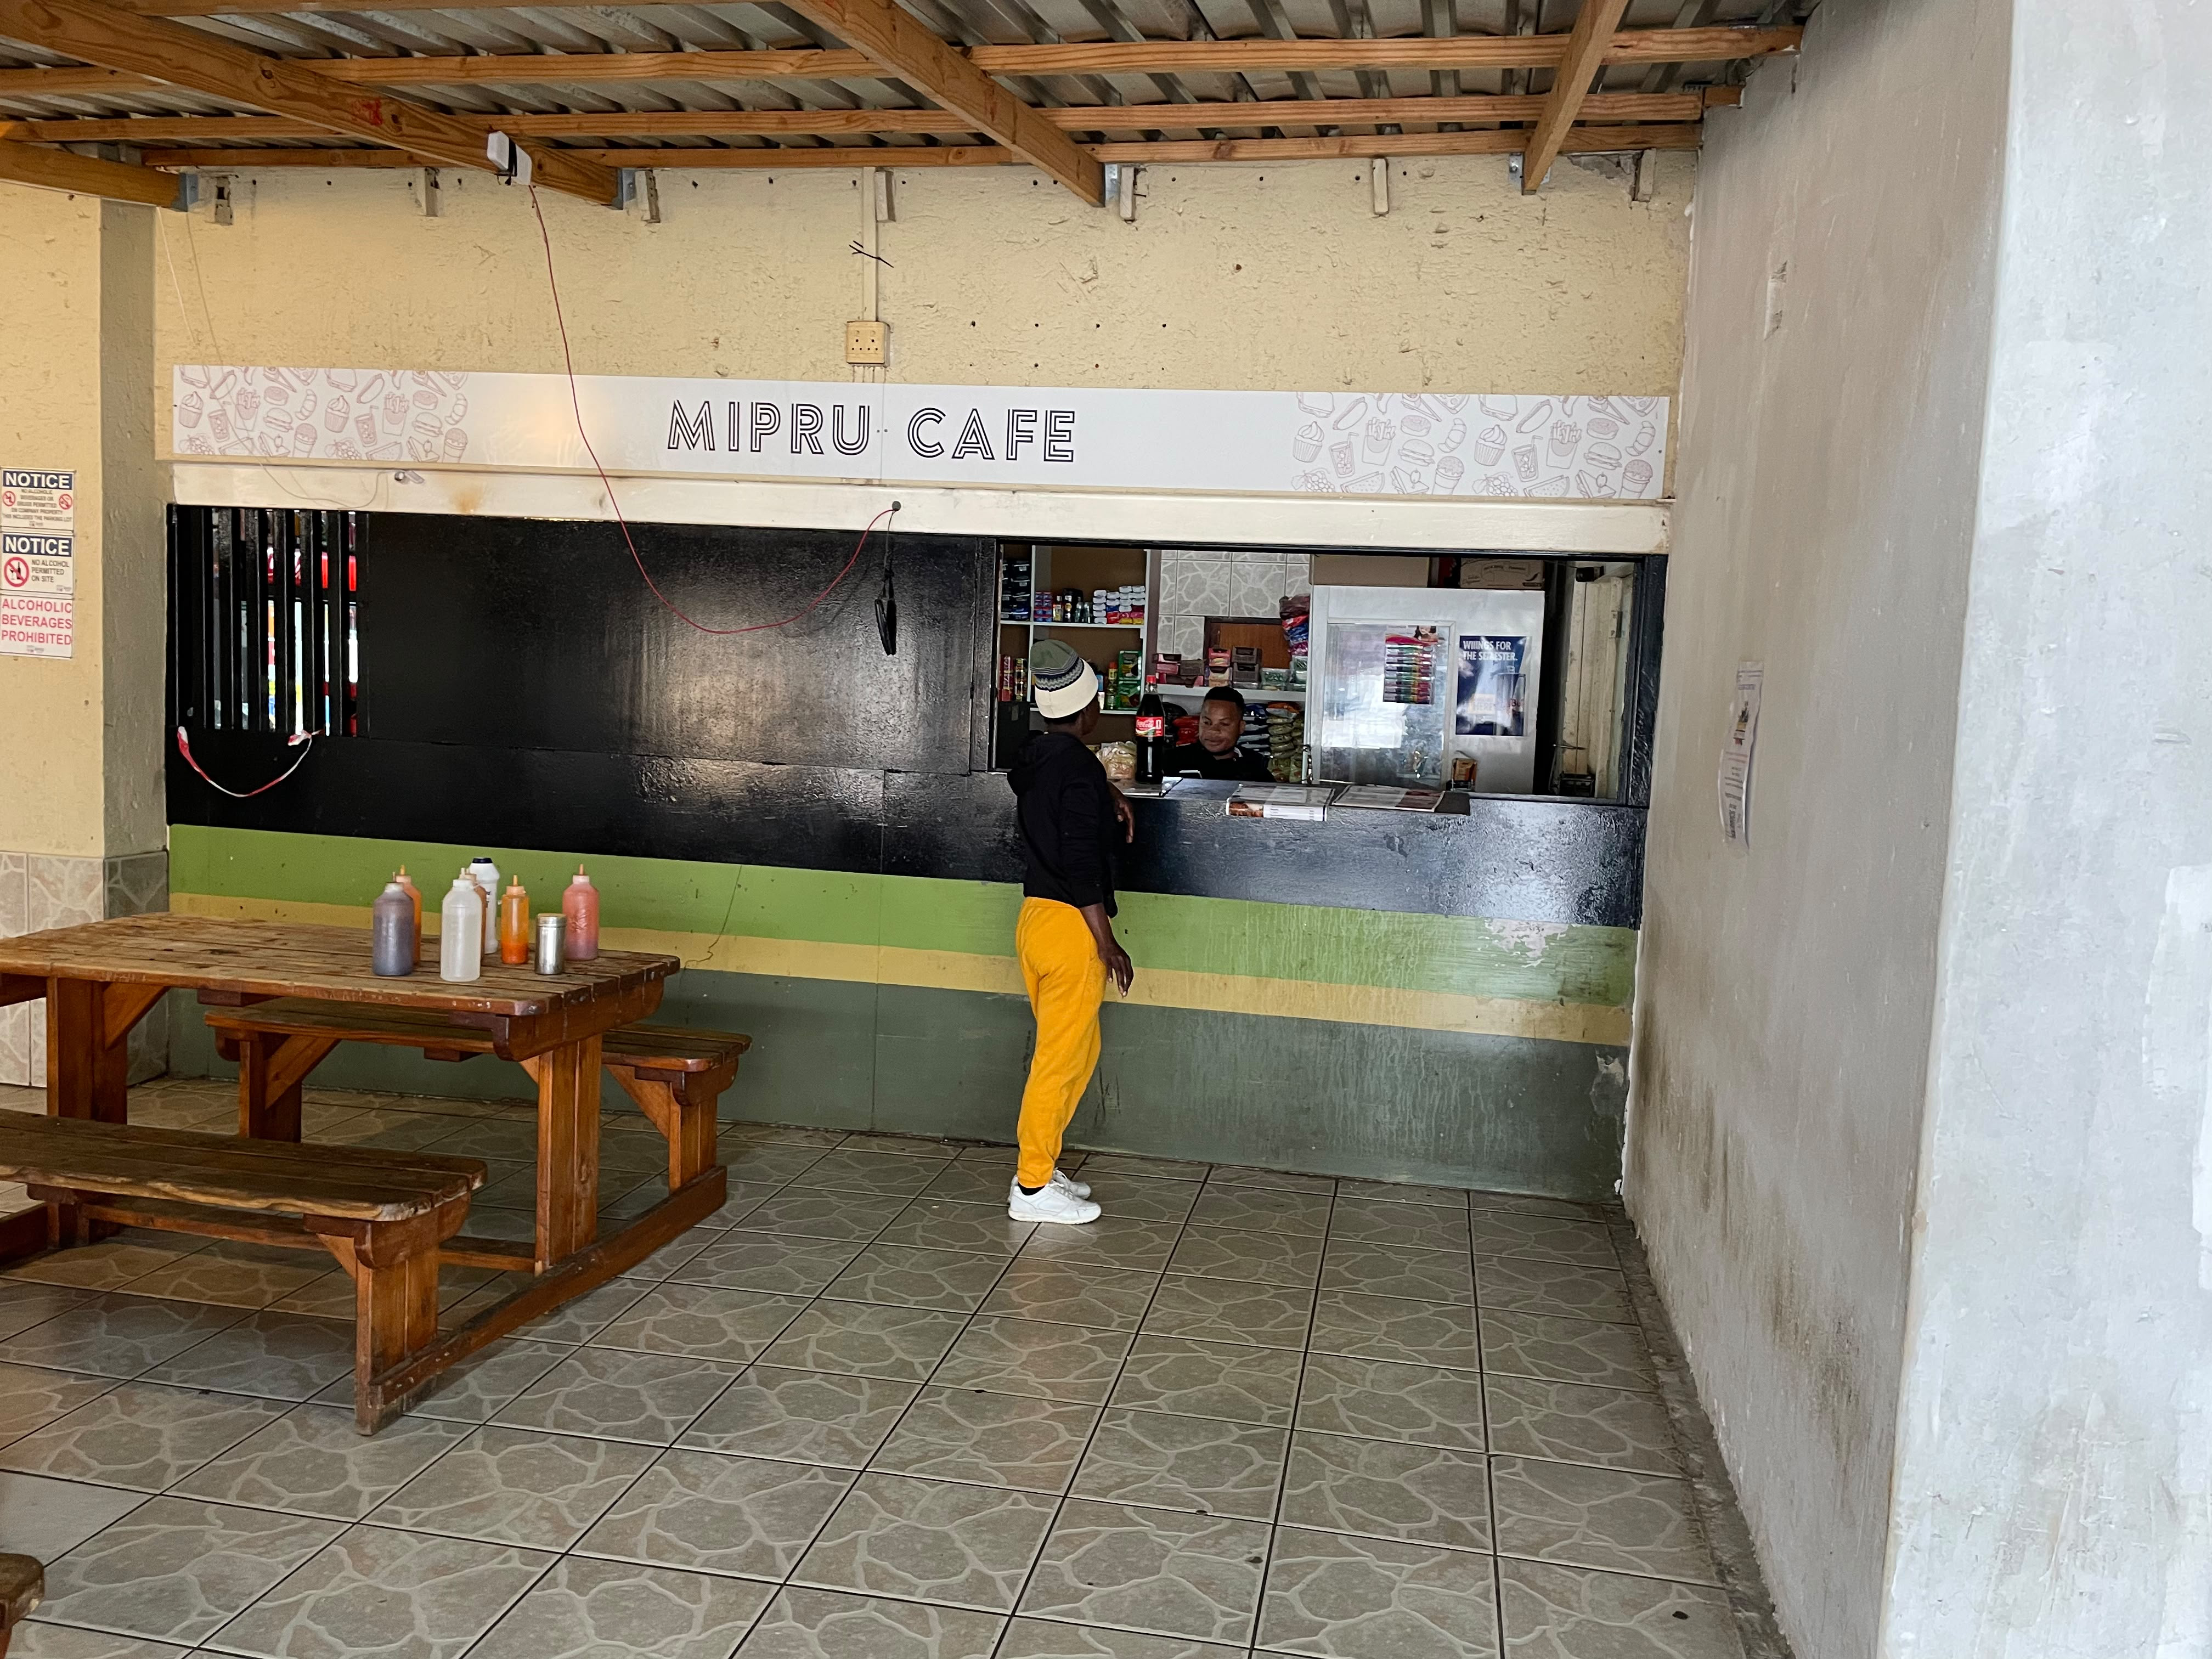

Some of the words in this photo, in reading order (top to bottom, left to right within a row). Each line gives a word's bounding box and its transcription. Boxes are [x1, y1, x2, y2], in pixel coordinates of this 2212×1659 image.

[667, 399, 870, 456] MIPRU
[907, 407, 1076, 462] CAFE
[5, 472, 70, 489] NOTICE
[5, 536, 70, 555] NOTICE
[31, 567, 65, 575] PERMITTED
[2, 599, 72, 613] ALCOHOLIC
[2, 614, 72, 629] BEVERAGES
[2, 630, 72, 645] PROHIBITED
[1496, 641, 1511, 651] FOR
[1463, 651, 1477, 661] THE
